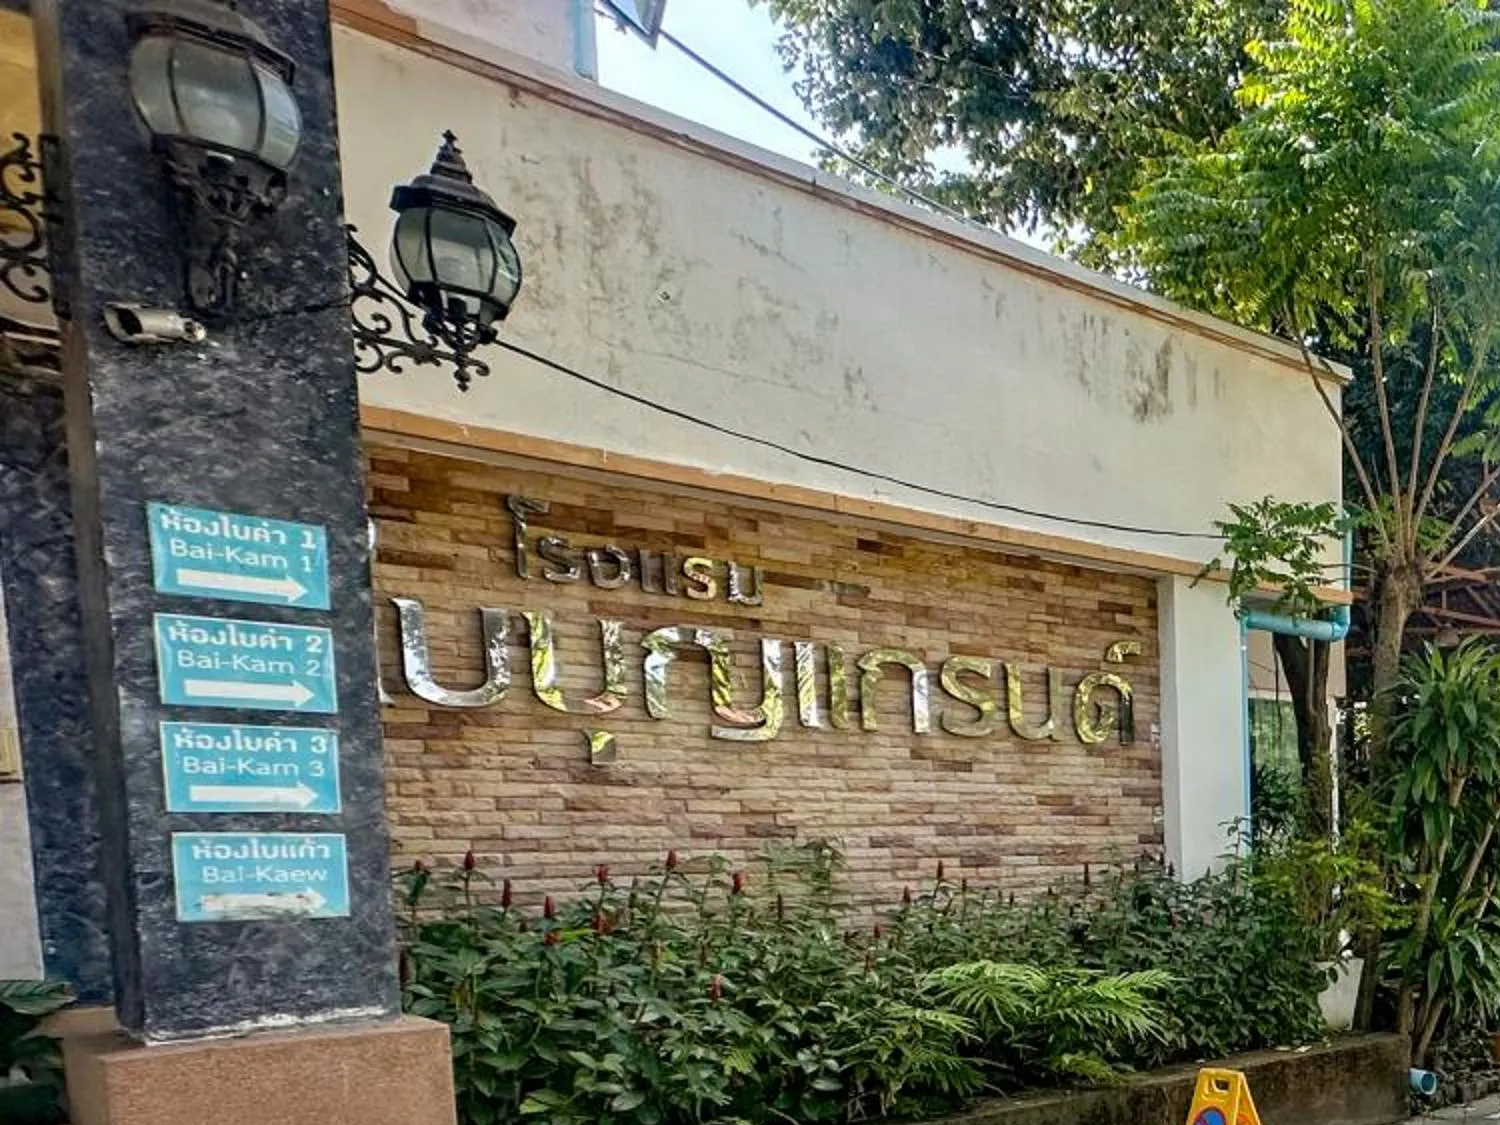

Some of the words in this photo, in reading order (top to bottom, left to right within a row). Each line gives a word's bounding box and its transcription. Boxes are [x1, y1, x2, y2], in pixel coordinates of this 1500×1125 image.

[300, 529, 317, 549] 1
[506, 493, 764, 607] โรงแรม
[169, 537, 289, 569] Bai-Kam
[301, 555, 313, 573] 1
[305, 634, 323, 653] 2
[367, 515, 1142, 765] บบุญแกรนด์
[177, 649, 296, 674] Bai-Kam
[305, 659, 322, 677] 2
[310, 735, 327, 754] 3
[183, 755, 299, 776] Bai-Kam
[308, 760, 325, 777] 3
[202, 864, 329, 884] Bai-Kaew
